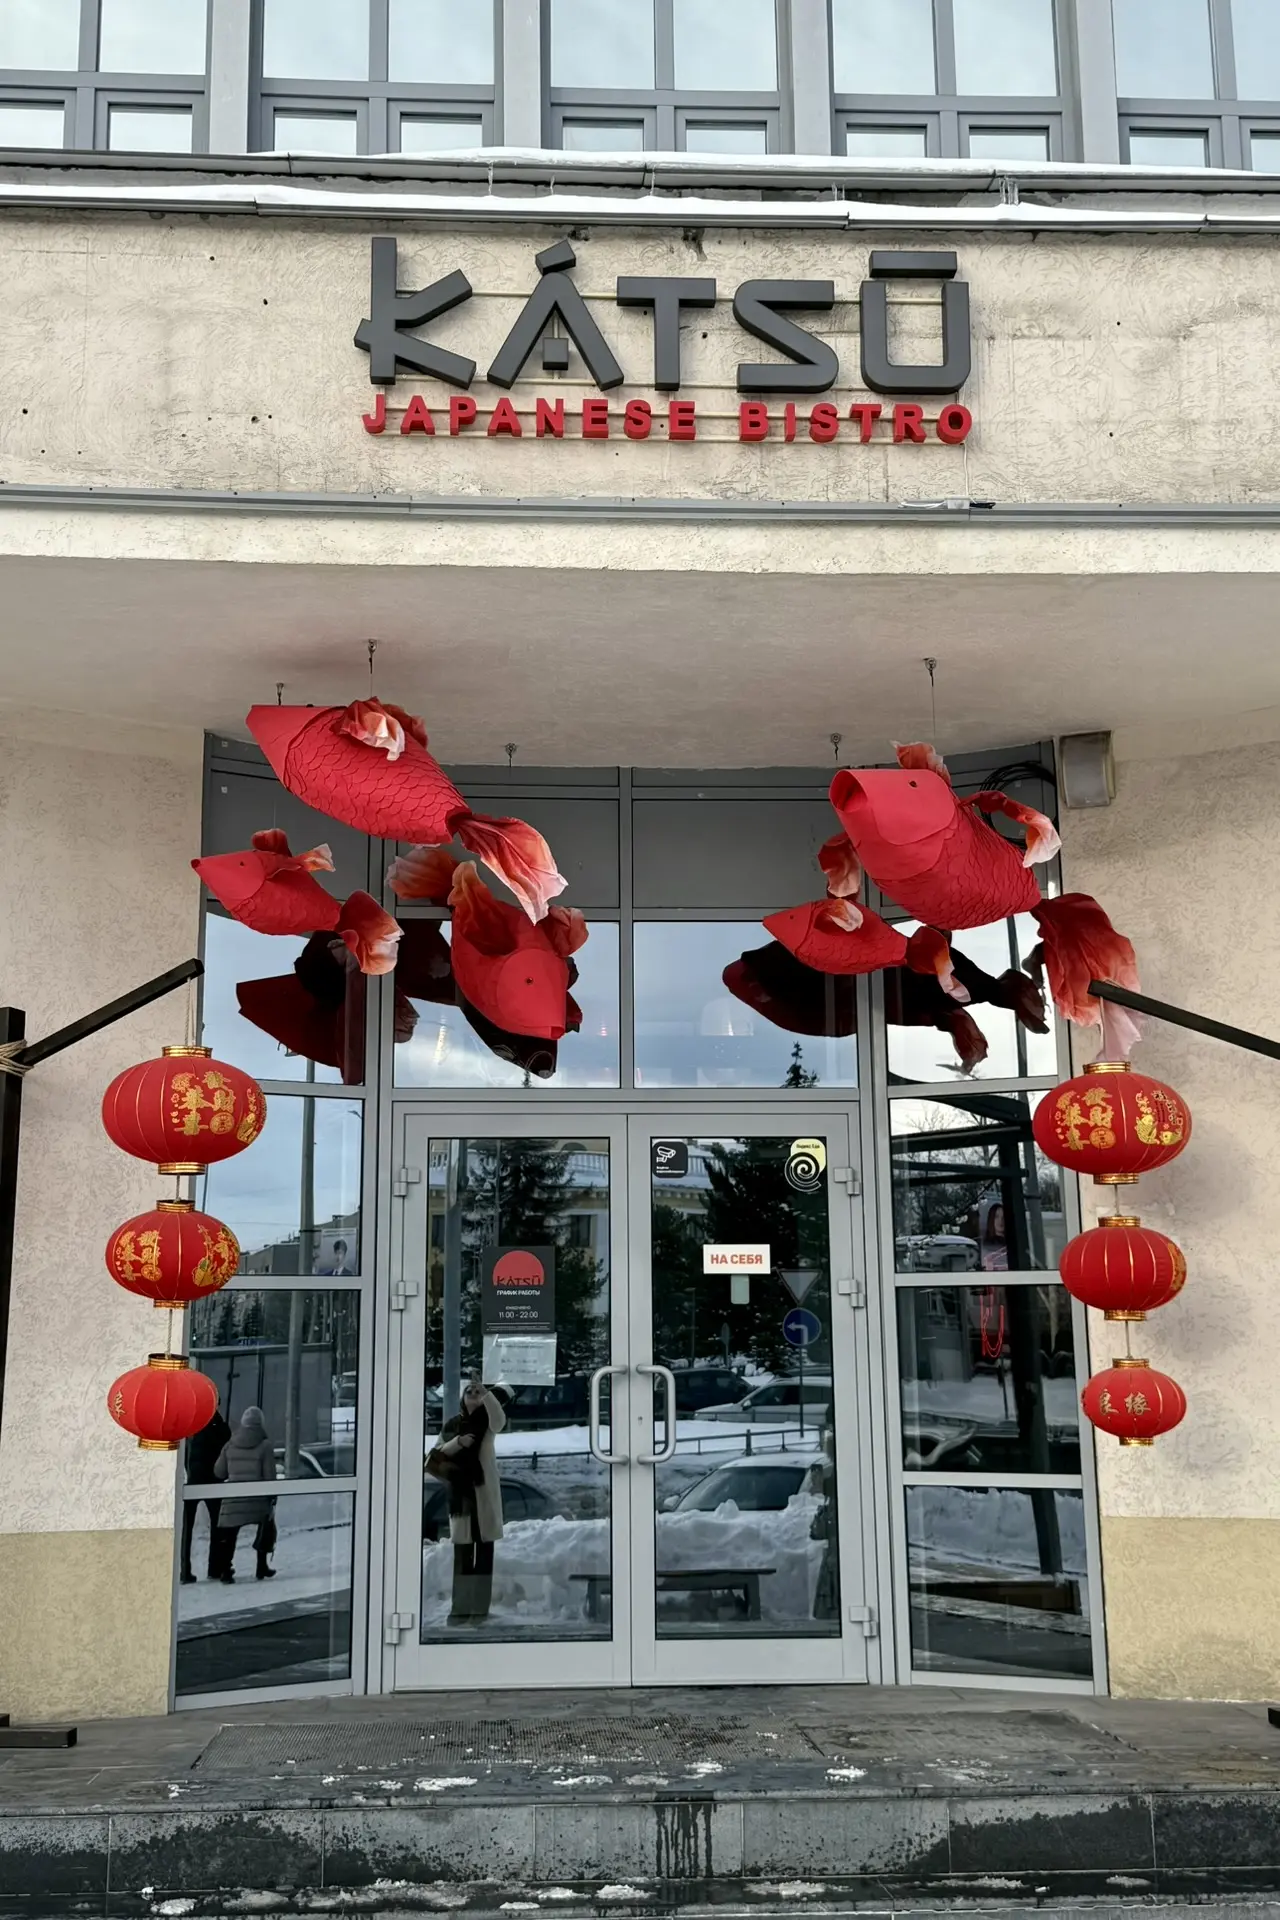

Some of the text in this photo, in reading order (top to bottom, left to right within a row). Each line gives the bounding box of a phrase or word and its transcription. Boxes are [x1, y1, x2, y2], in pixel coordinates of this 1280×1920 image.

[362, 394, 973, 444] JAPANESE BISTRO
[710, 1254, 763, 1265] НА СЕБЯ
